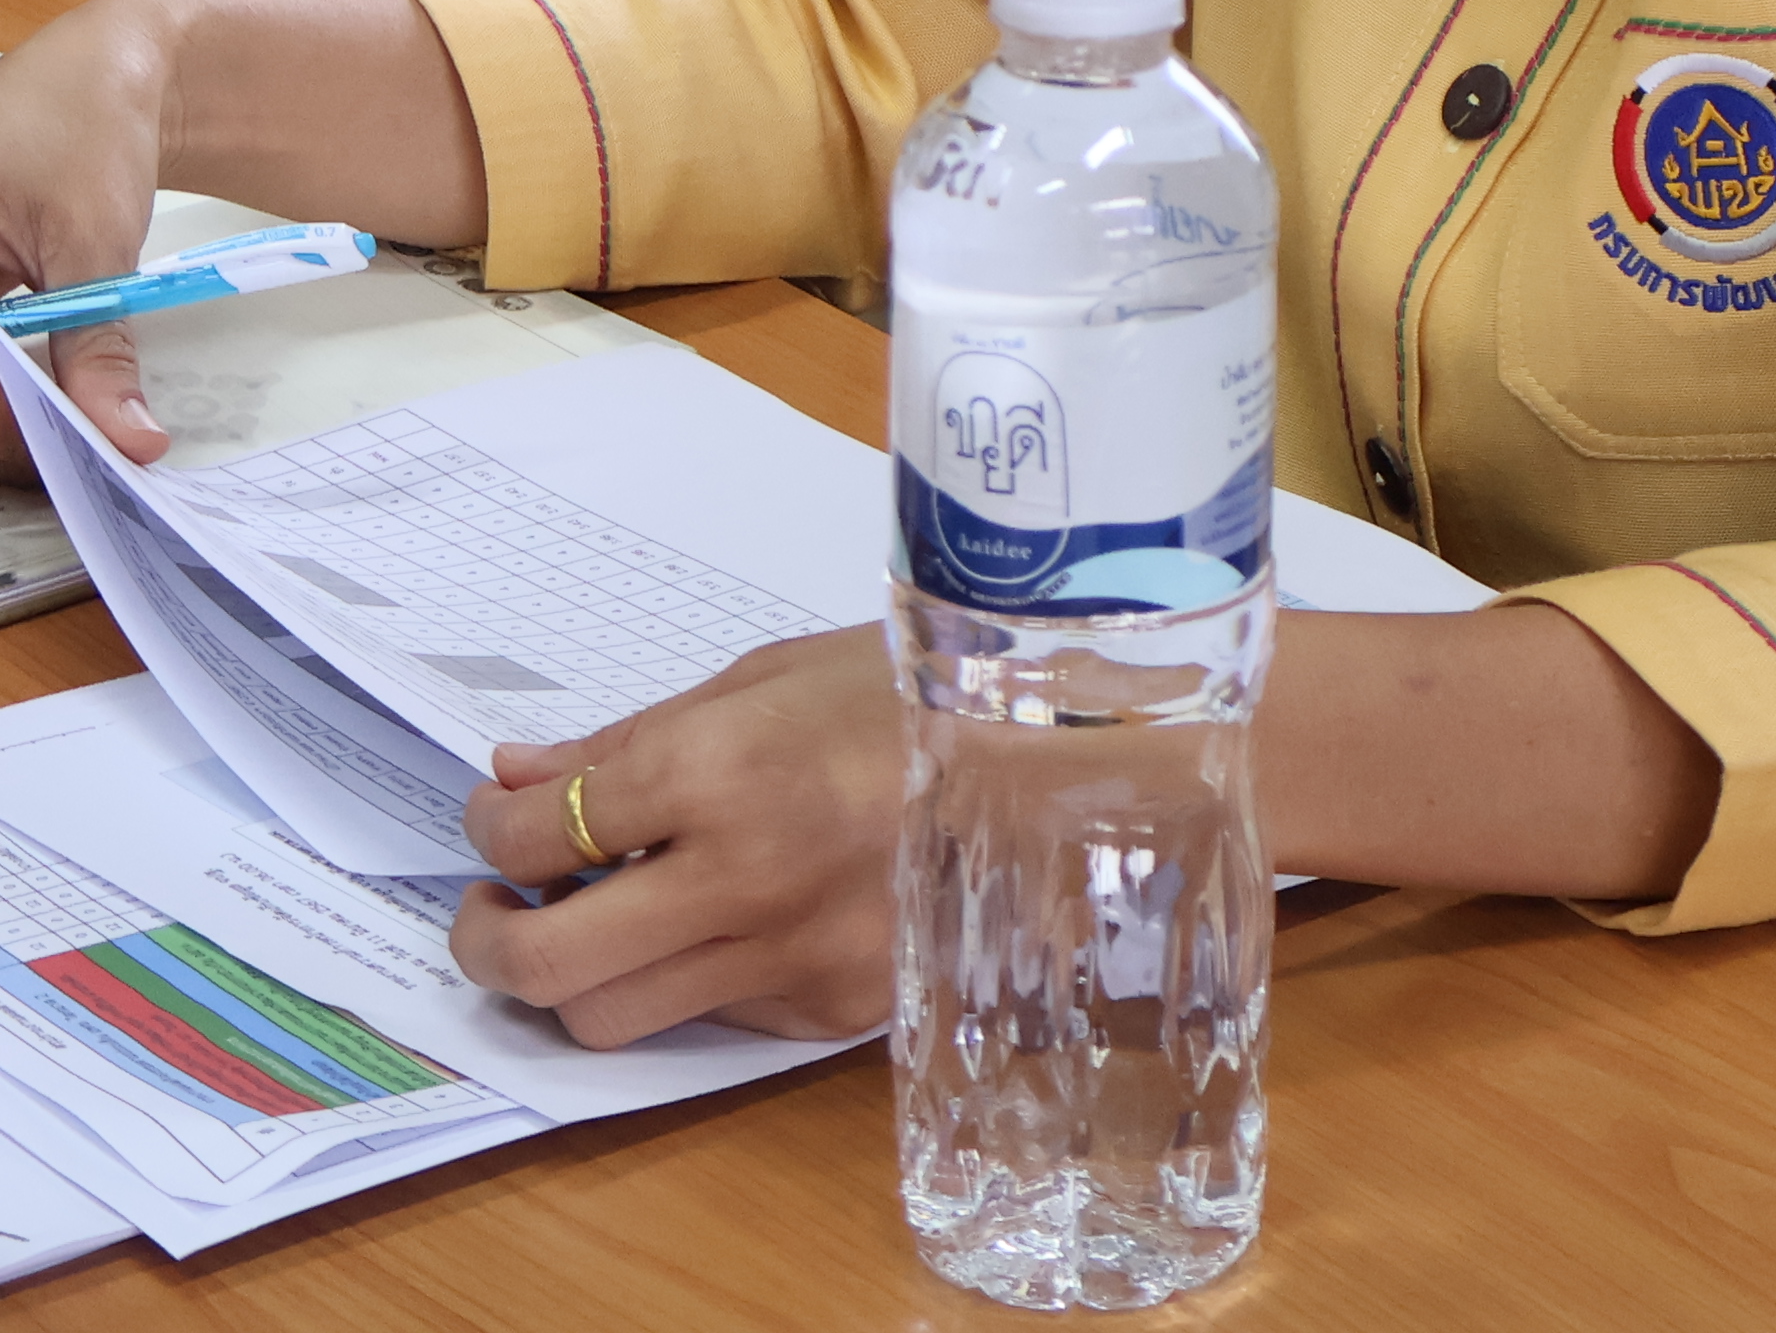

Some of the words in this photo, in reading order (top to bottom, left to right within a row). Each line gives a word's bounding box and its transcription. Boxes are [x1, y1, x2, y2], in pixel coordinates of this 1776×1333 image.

[314, 226, 336, 238] 0.7
[945, 396, 1048, 495] ขายดี
[959, 533, 1033, 561] kaidee
